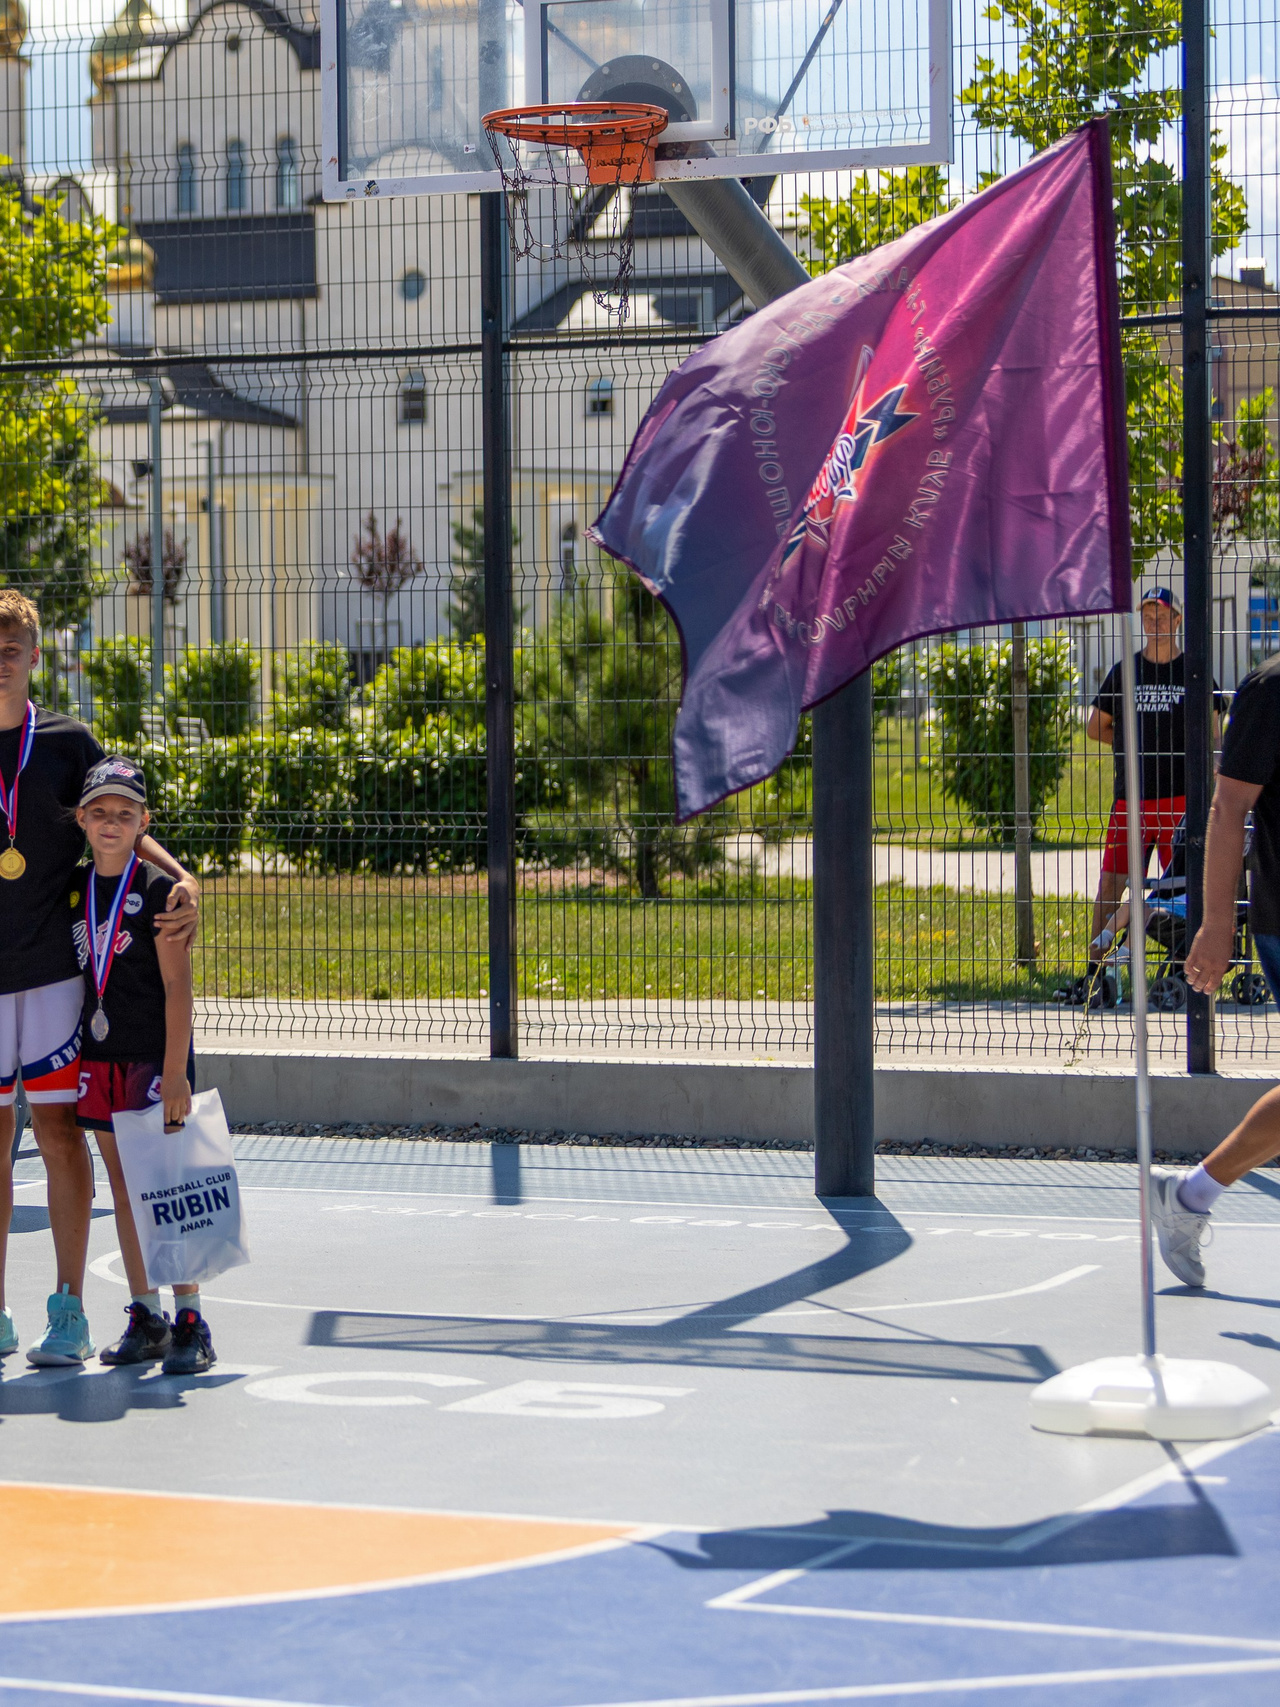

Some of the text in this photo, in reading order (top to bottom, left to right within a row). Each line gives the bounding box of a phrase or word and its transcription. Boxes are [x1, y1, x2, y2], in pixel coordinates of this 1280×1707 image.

[744, 115, 792, 135] РФБ
[205, 1172, 232, 1186] CLUB
[152, 1186, 231, 1226] RUBIN
[180, 1217, 214, 1234] ANAPA
